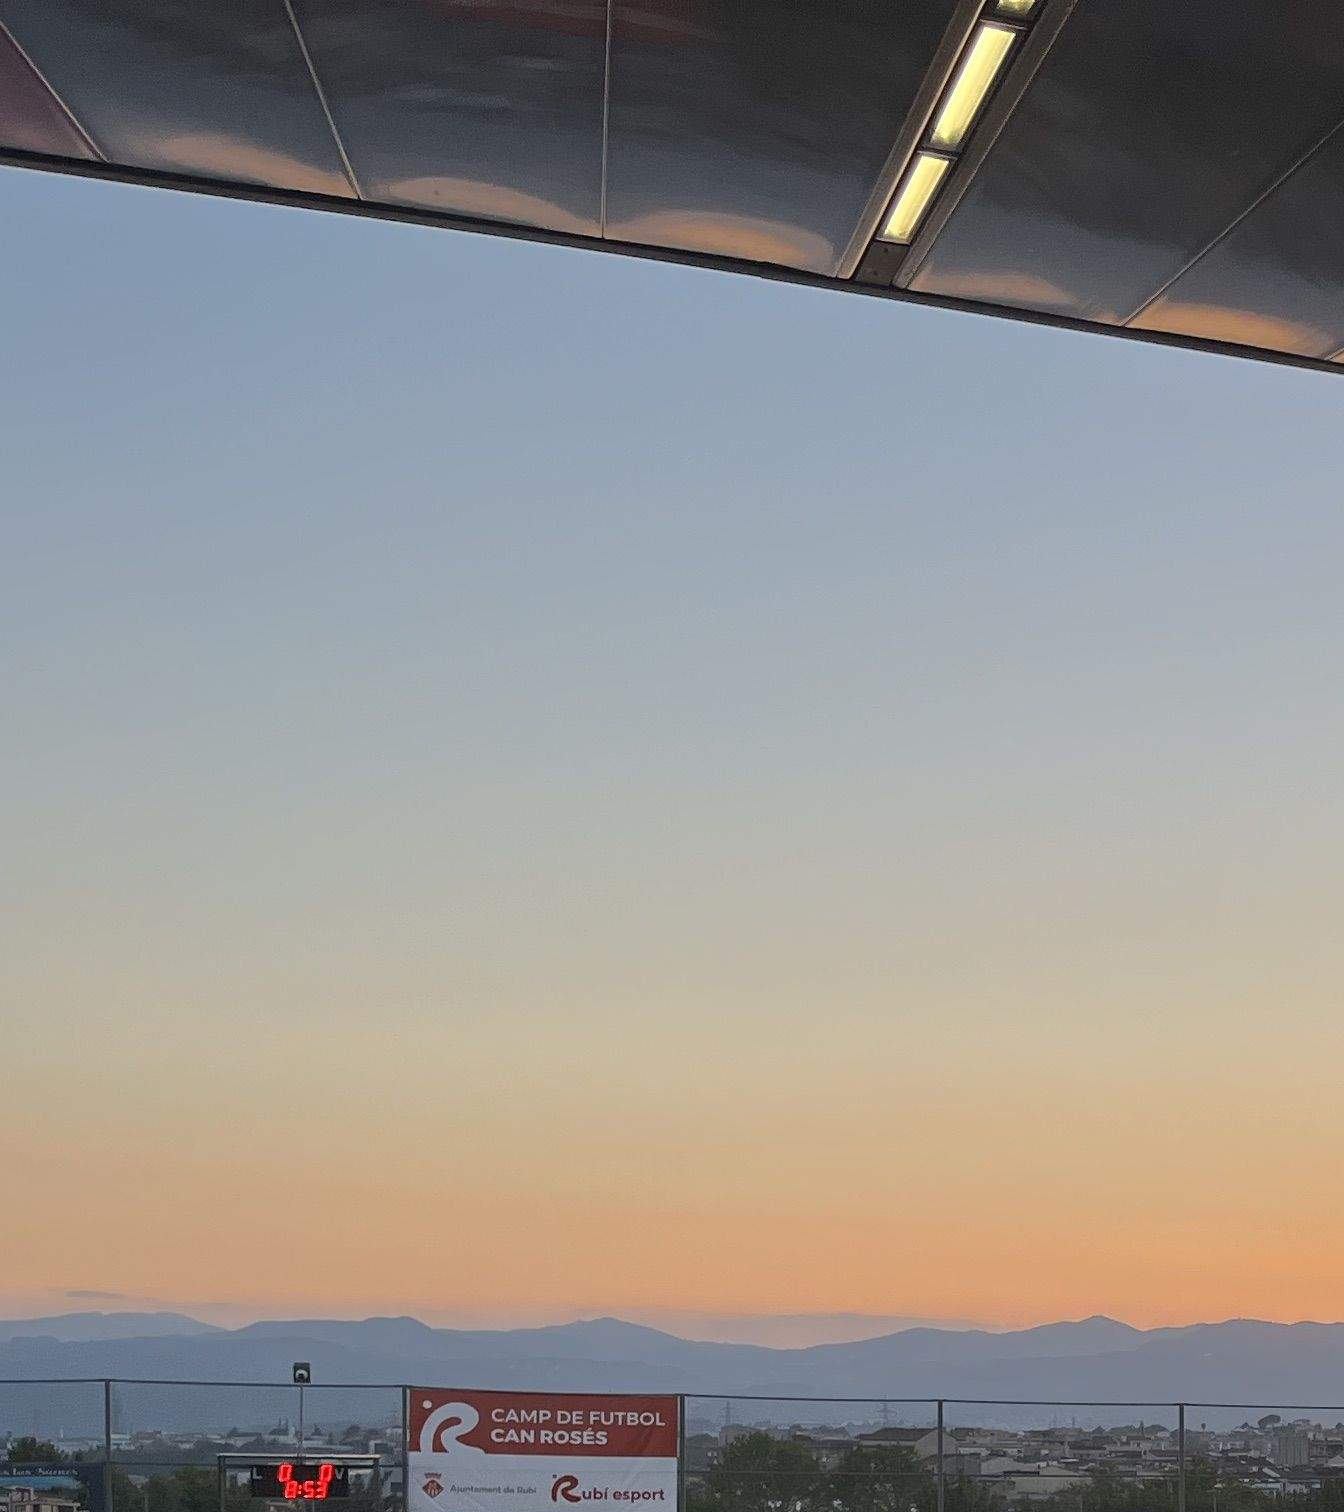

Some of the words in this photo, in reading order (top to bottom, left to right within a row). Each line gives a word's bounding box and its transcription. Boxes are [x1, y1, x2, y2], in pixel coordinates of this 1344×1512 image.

[491, 1408, 551, 1425] CAMP
[556, 1410, 583, 1425] DE
[589, 1411, 666, 1427] FUTBOL
[490, 1428, 536, 1444] CAN
[540, 1427, 608, 1446] ROSÉS
[450, 1484, 502, 1495] Ajuntament
[613, 1489, 665, 1504] esport
